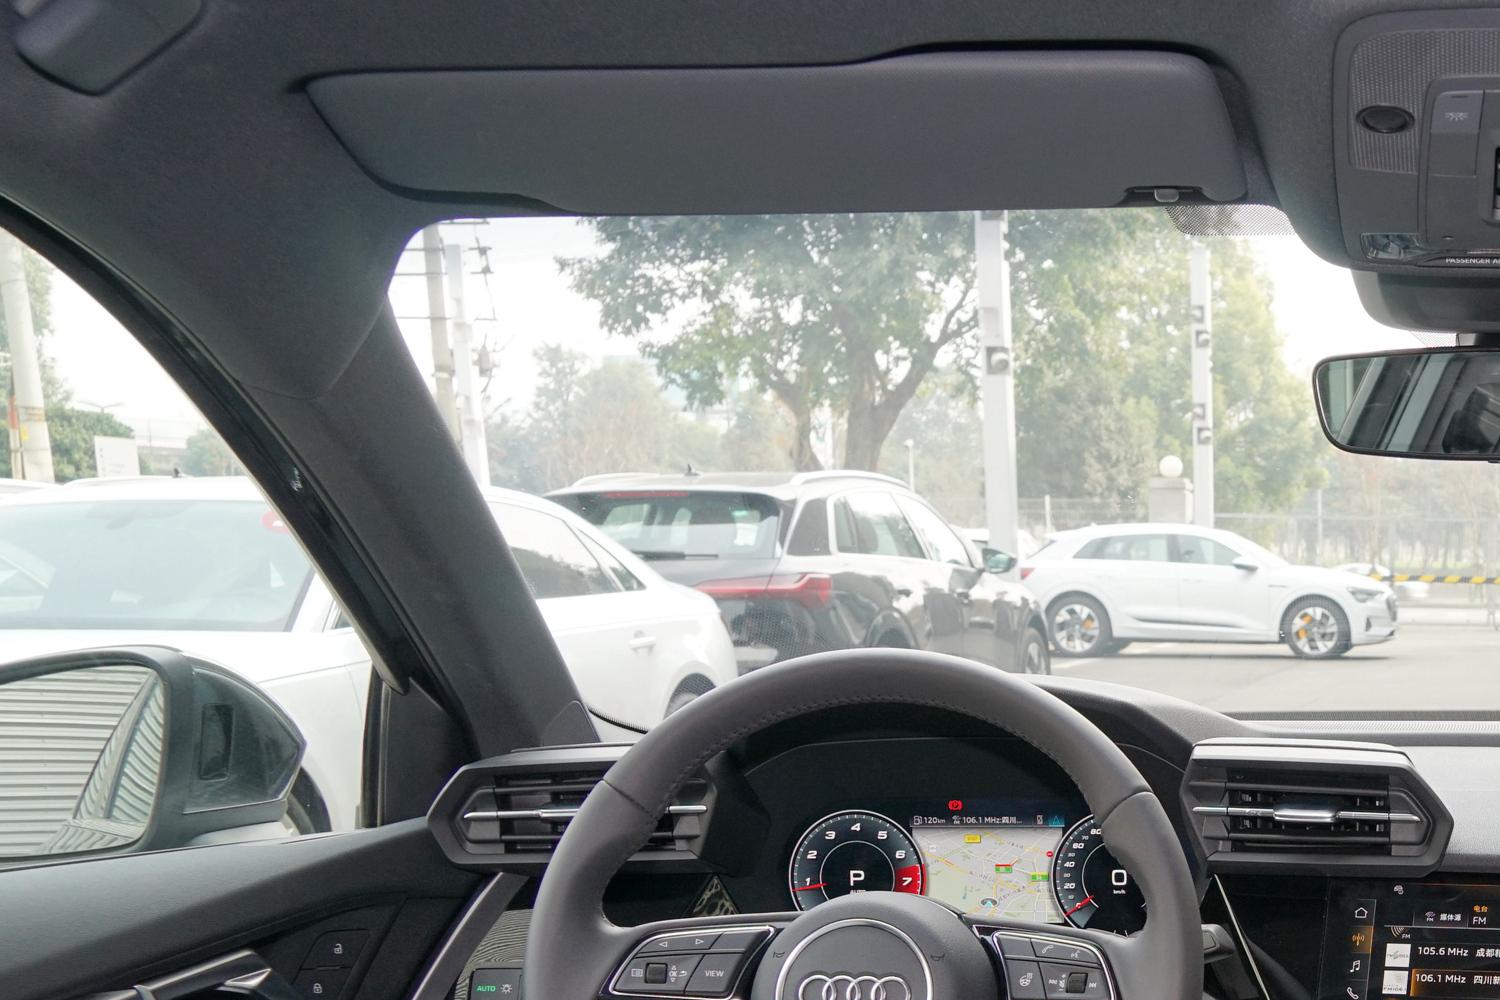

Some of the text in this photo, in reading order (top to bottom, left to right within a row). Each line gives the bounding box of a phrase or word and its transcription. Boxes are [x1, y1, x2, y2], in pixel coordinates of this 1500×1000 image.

[850, 823, 861, 831] 4
[825, 831, 836, 839] 3
[878, 831, 887, 839] 5
[807, 850, 817, 859] 2
[896, 850, 905, 859] 6
[805, 878, 811, 886] 1
[850, 870, 865, 886] P
[902, 877, 912, 886] 7
[1440, 913, 1461, 921] 媒体源
[1418, 946, 1446, 956] 105.6
[1448, 947, 1469, 957] MHz
[1416, 973, 1442, 982] 106.1
[1445, 974, 1466, 984] MHz
